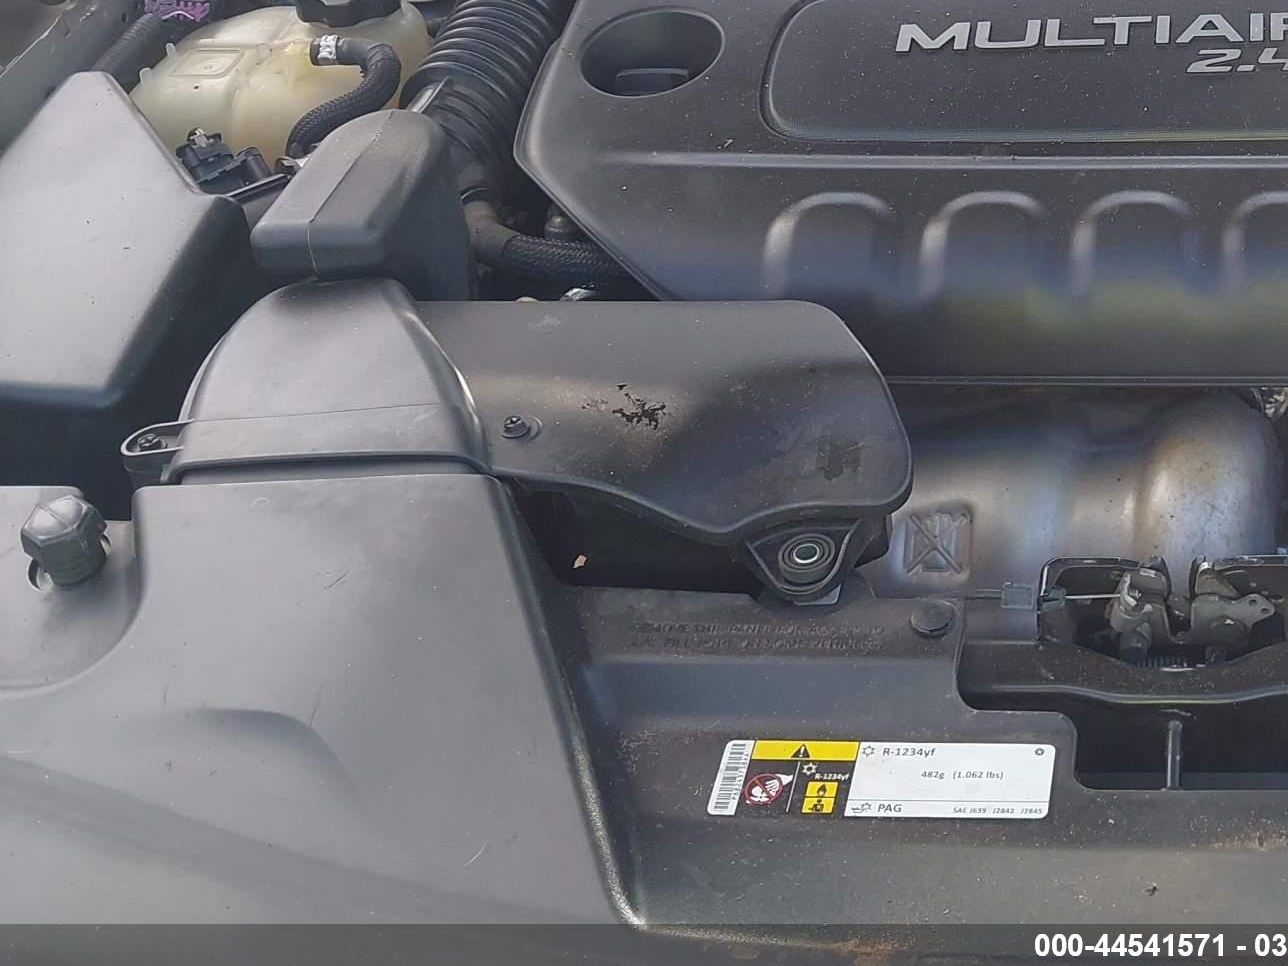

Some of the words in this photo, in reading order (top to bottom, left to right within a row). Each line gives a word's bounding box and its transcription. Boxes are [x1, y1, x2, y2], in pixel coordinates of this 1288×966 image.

[882, 747, 935, 758] R-1234yf
[920, 770, 945, 780] 482g
[952, 770, 984, 780] (1.062
[985, 770, 1004, 780] lbs)
[877, 803, 902, 813] PAG
